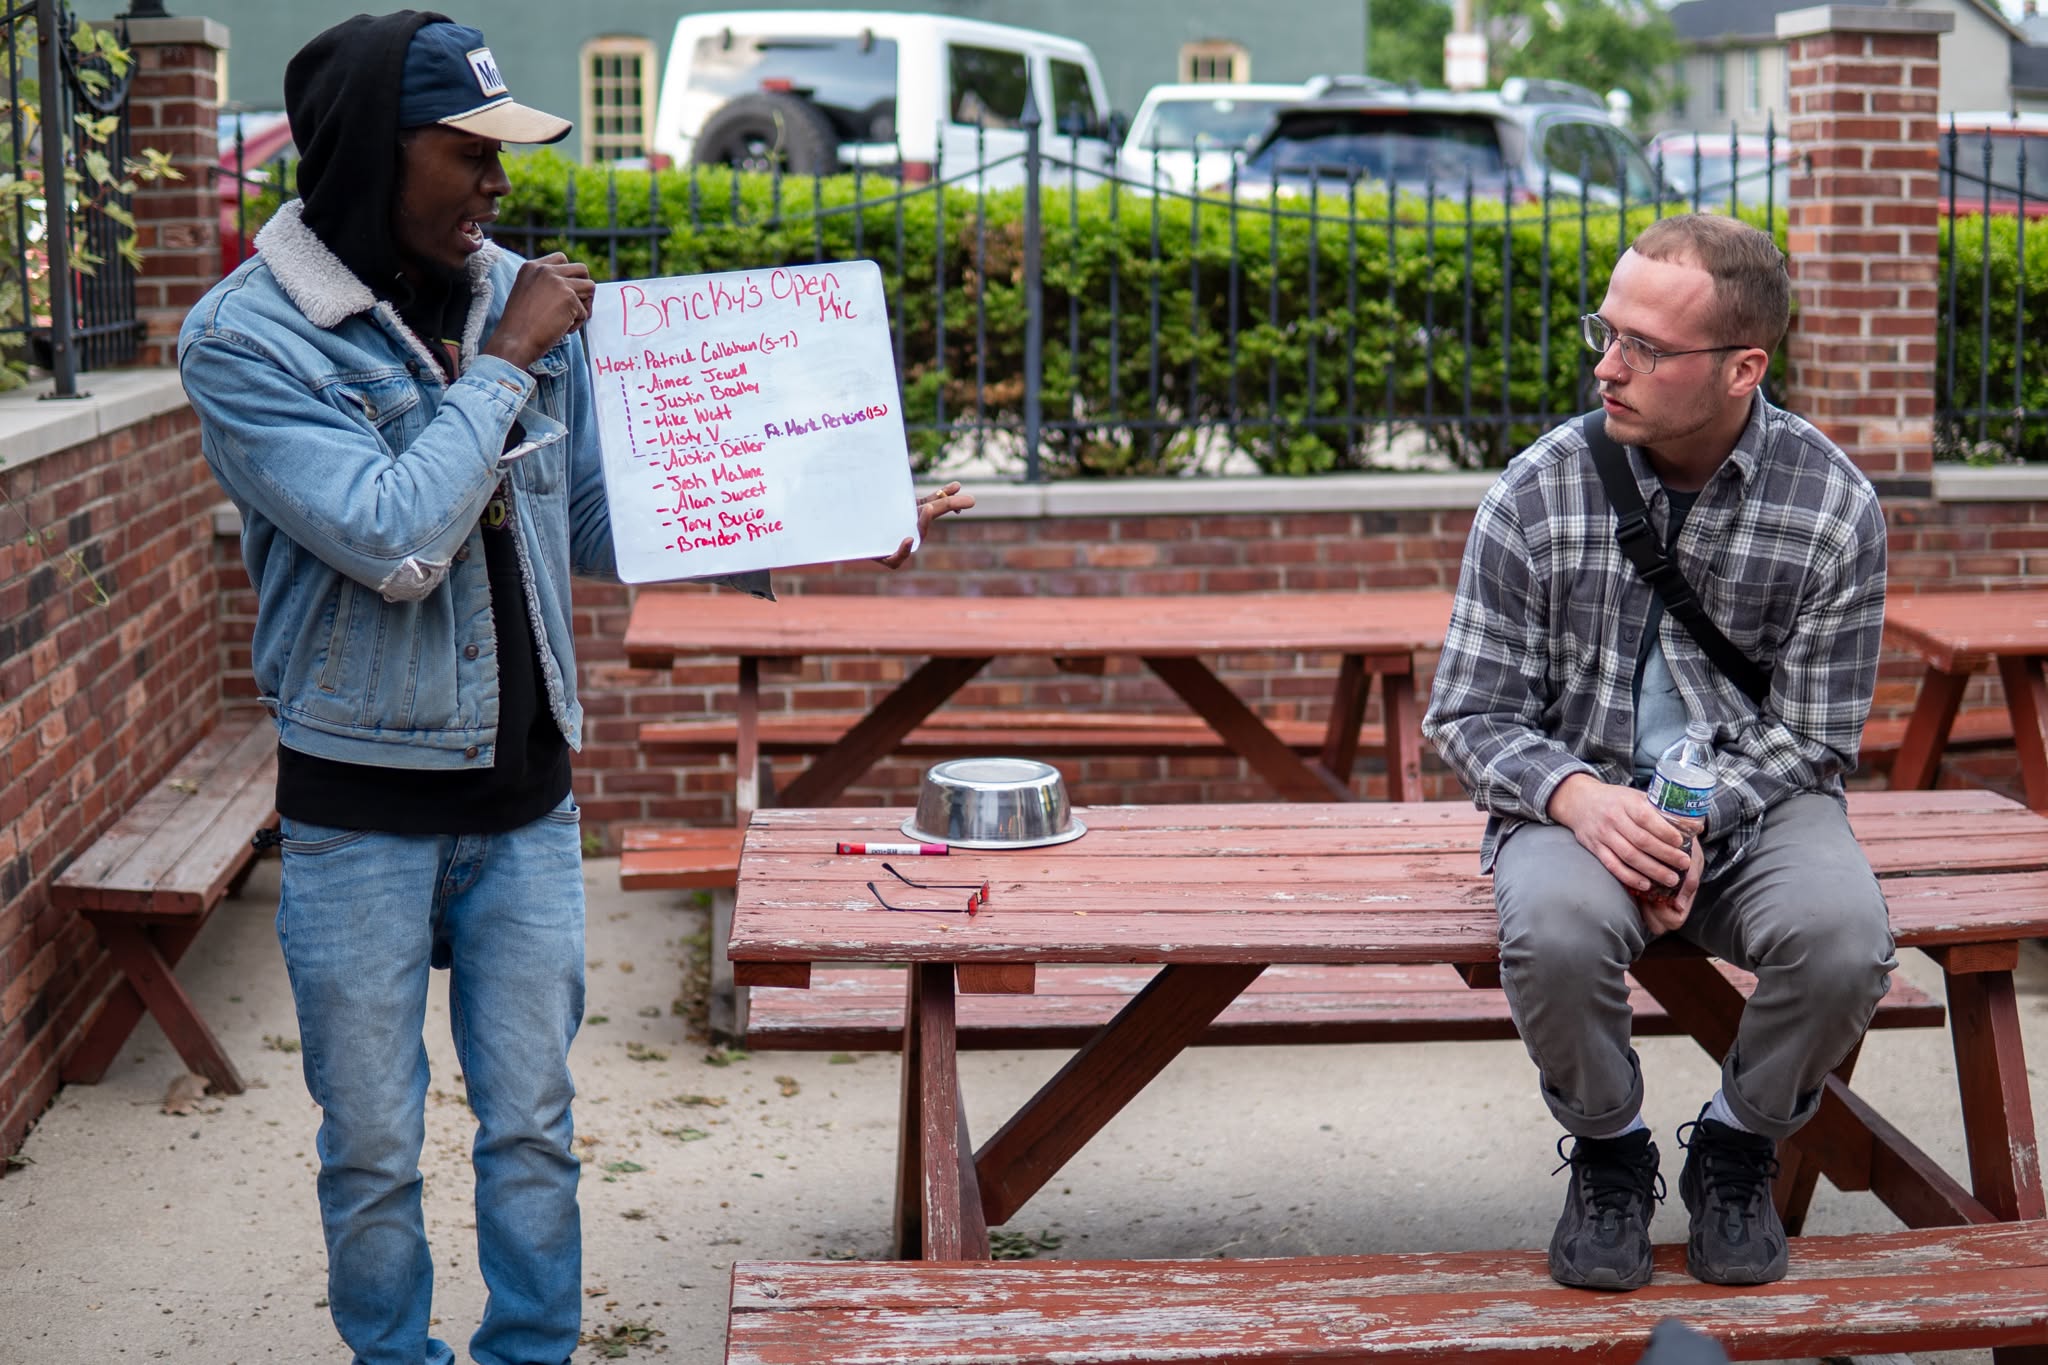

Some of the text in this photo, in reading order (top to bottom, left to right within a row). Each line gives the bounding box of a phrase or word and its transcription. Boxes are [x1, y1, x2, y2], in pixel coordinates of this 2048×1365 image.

[770, 267, 840, 306] Open
[819, 290, 857, 322] Mic
[644, 348, 696, 370] Patrick
[700, 362, 747, 383] Jewell
[720, 480, 768, 504] Sweet
